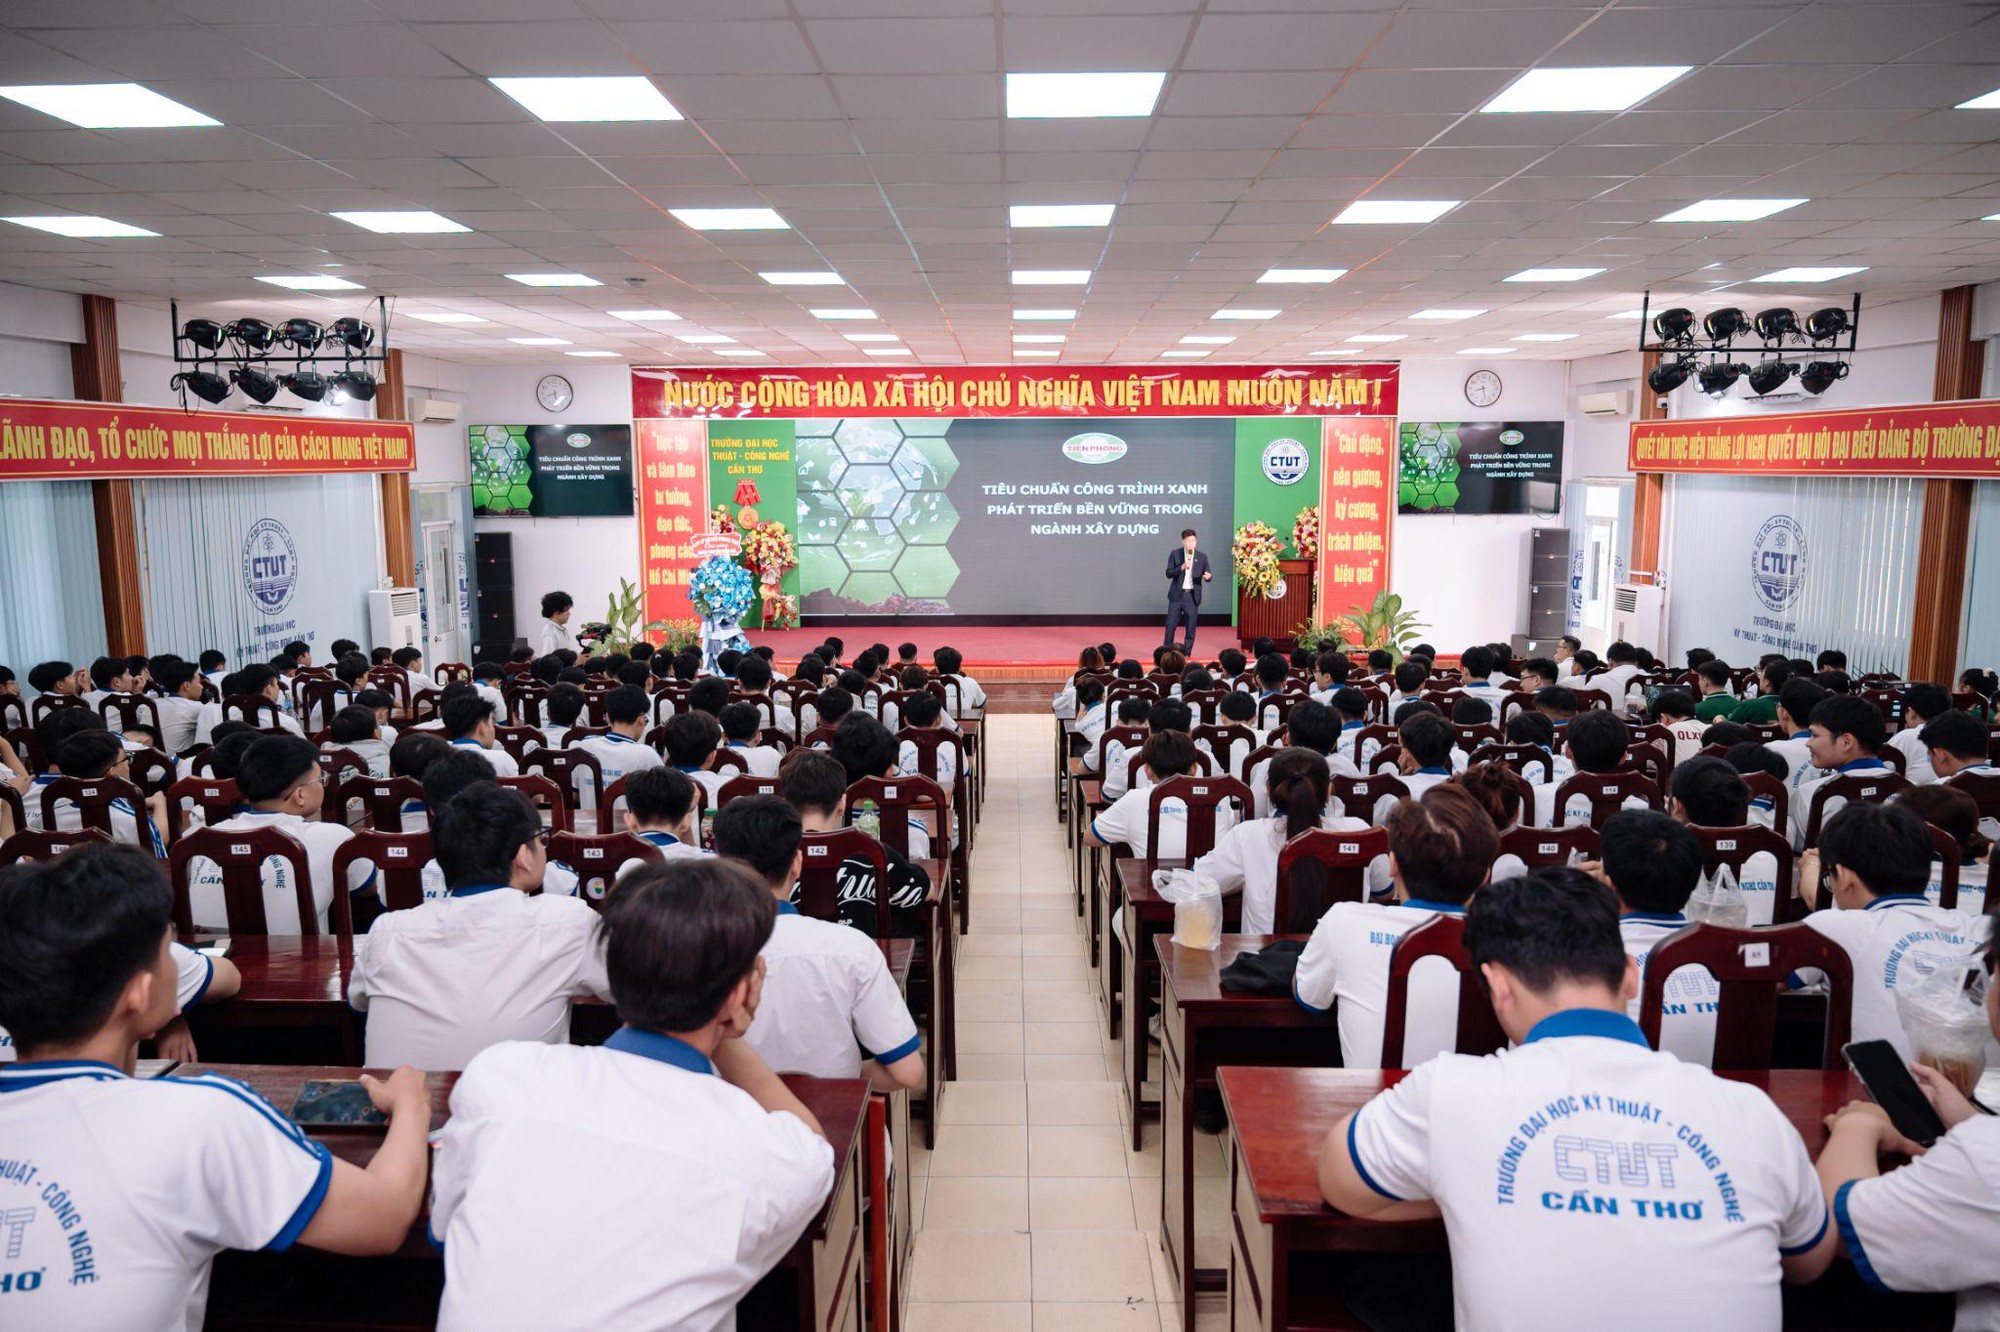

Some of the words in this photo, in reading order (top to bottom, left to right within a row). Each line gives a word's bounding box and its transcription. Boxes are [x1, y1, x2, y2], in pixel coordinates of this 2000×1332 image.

[664, 374, 734, 407] NƯỚC
[740, 375, 810, 413] CỘNG
[816, 374, 868, 407] HÒA
[872, 375, 908, 407] XÃ
[914, 375, 955, 413] HỘI
[961, 373, 1012, 408] CHỦ
[1018, 374, 1096, 408] NGHĨA
[1102, 374, 1154, 413] VIỆT
[1162, 379, 1220, 406] NAM
[1227, 374, 1303, 407] MUÔN
[1309, 373, 1368, 407] NĂM
[1373, 378, 1382, 405] !
[50, 426, 96, 467] ĐẠO,
[98, 416, 121, 460] TỔ
[125, 423, 170, 460] CHỨC
[172, 430, 203, 466] MỌI
[205, 422, 250, 460] THẮNG
[252, 432, 272, 466] LỢI
[275, 426, 300, 461] CỦA
[302, 431, 330, 461] CÁCH
[332, 436, 362, 465] MẠNG
[363, 432, 382, 465] VIỆT
[711, 437, 743, 448] TRƯỜNG
[762, 438, 778, 449] HỌC
[1707, 426, 1731, 460] THẮNG
[1746, 434, 1767, 466] NGHỊ
[1767, 425, 1795, 463] QUYẾT
[1796, 432, 1813, 466] ĐẠI
[1814, 426, 1831, 466] HỘI
[1832, 430, 1850, 466] ĐẠI
[1852, 418, 1877, 460] BIỂU
[1878, 419, 1910, 459] ĐẢNG
[1912, 420, 1930, 466] BỘ
[1932, 418, 1983, 459] TRƯỜNG
[1985, 425, 2000, 466] ĐẠ
[744, 450, 767, 461] CÔNG
[768, 450, 790, 462] NGHỆ
[1270, 456, 1300, 467] CTUT
[658, 462, 675, 478] làm
[982, 481, 1016, 495] TIÊU
[1020, 480, 1070, 495] CHUẨN
[1073, 480, 1114, 495] CÔNG
[1117, 480, 1165, 495] TRÌNH
[1167, 483, 1208, 495] XANH
[987, 501, 1025, 515] PHÁT
[1028, 500, 1072, 515] TRIỂN
[1076, 500, 1105, 515] BỀN
[1108, 500, 1150, 515] VỮNG
[1153, 504, 1203, 515] TRONG
[1031, 521, 1082, 535] NGÀNH
[1085, 521, 1114, 535] XÂY
[1117, 522, 1160, 537] DỰNG
[1328, 532, 1351, 551] trách
[650, 542, 676, 560] phong
[252, 554, 287, 579] CTUT
[1761, 550, 1798, 576] CTUT
[649, 567, 661, 585] Hồ
[84, 788, 96, 797] 124
[235, 845, 249, 854] 145
[391, 848, 405, 856] 144
[586, 849, 600, 857] 143
[810, 847, 825, 855] 142
[1343, 844, 1356, 852] 141
[1542, 844, 1556, 852] 140
[1719, 841, 1734, 850] 139
[1667, 970, 1718, 998] TUT
[1497, 1136, 1527, 1205] TRƯỜNG
[1519, 1112, 1548, 1140] ĐẠI
[1545, 1095, 1580, 1121] HỌC
[1581, 1090, 1602, 1112] KỸ
[1607, 1096, 1663, 1124] THUẬT
[1676, 1124, 1721, 1171] CÔNG
[1714, 1172, 1746, 1224] NGHỆ
[1553, 1134, 1680, 1189] CTUT
[1541, 1188, 1620, 1216] CẦN
[1630, 1199, 1704, 1221] THƠ
[41, 1181, 83, 1231] CÔNG
[67, 1228, 101, 1287] NGHỆ
